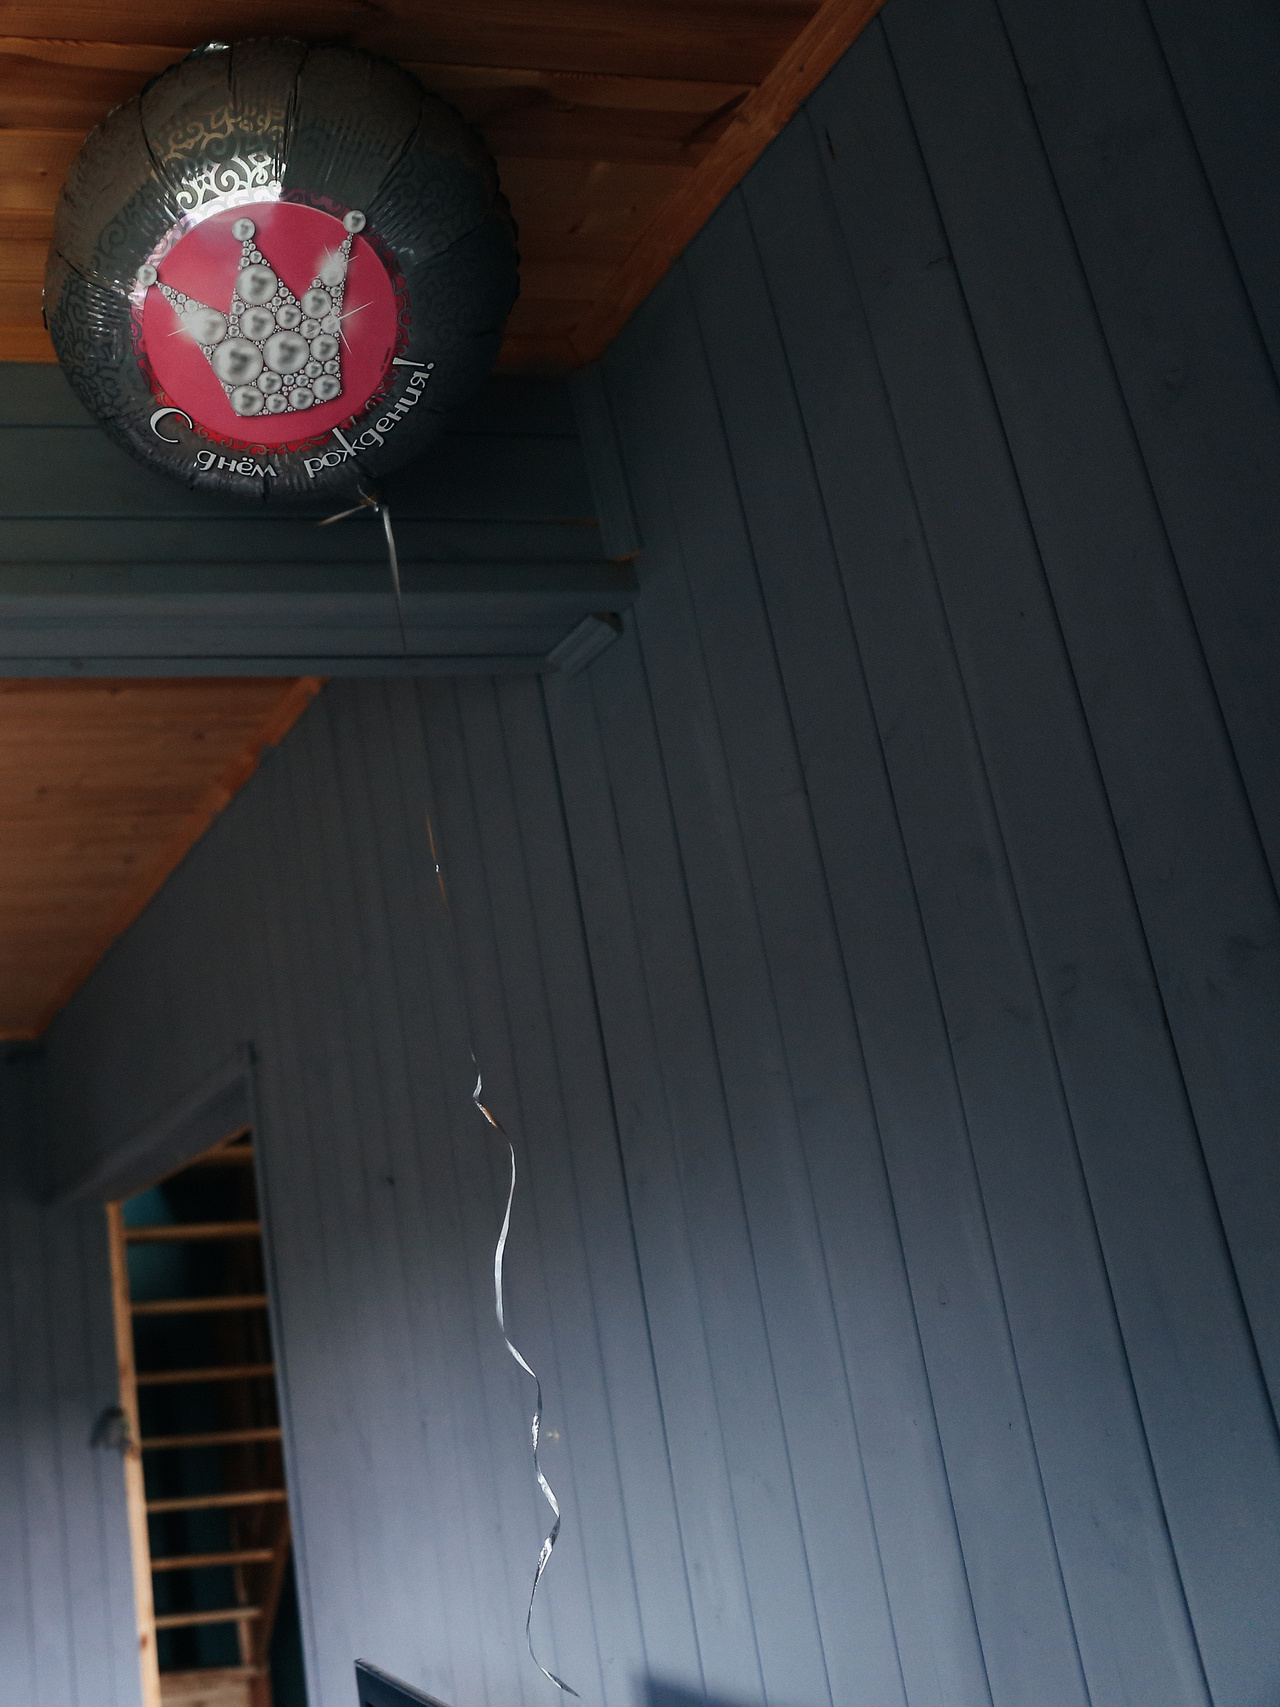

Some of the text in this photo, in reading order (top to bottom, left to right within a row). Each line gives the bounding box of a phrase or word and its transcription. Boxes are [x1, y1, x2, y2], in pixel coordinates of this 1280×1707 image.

[149, 406, 194, 443] С
[195, 450, 278, 478] днём
[303, 356, 435, 479] рождения!
